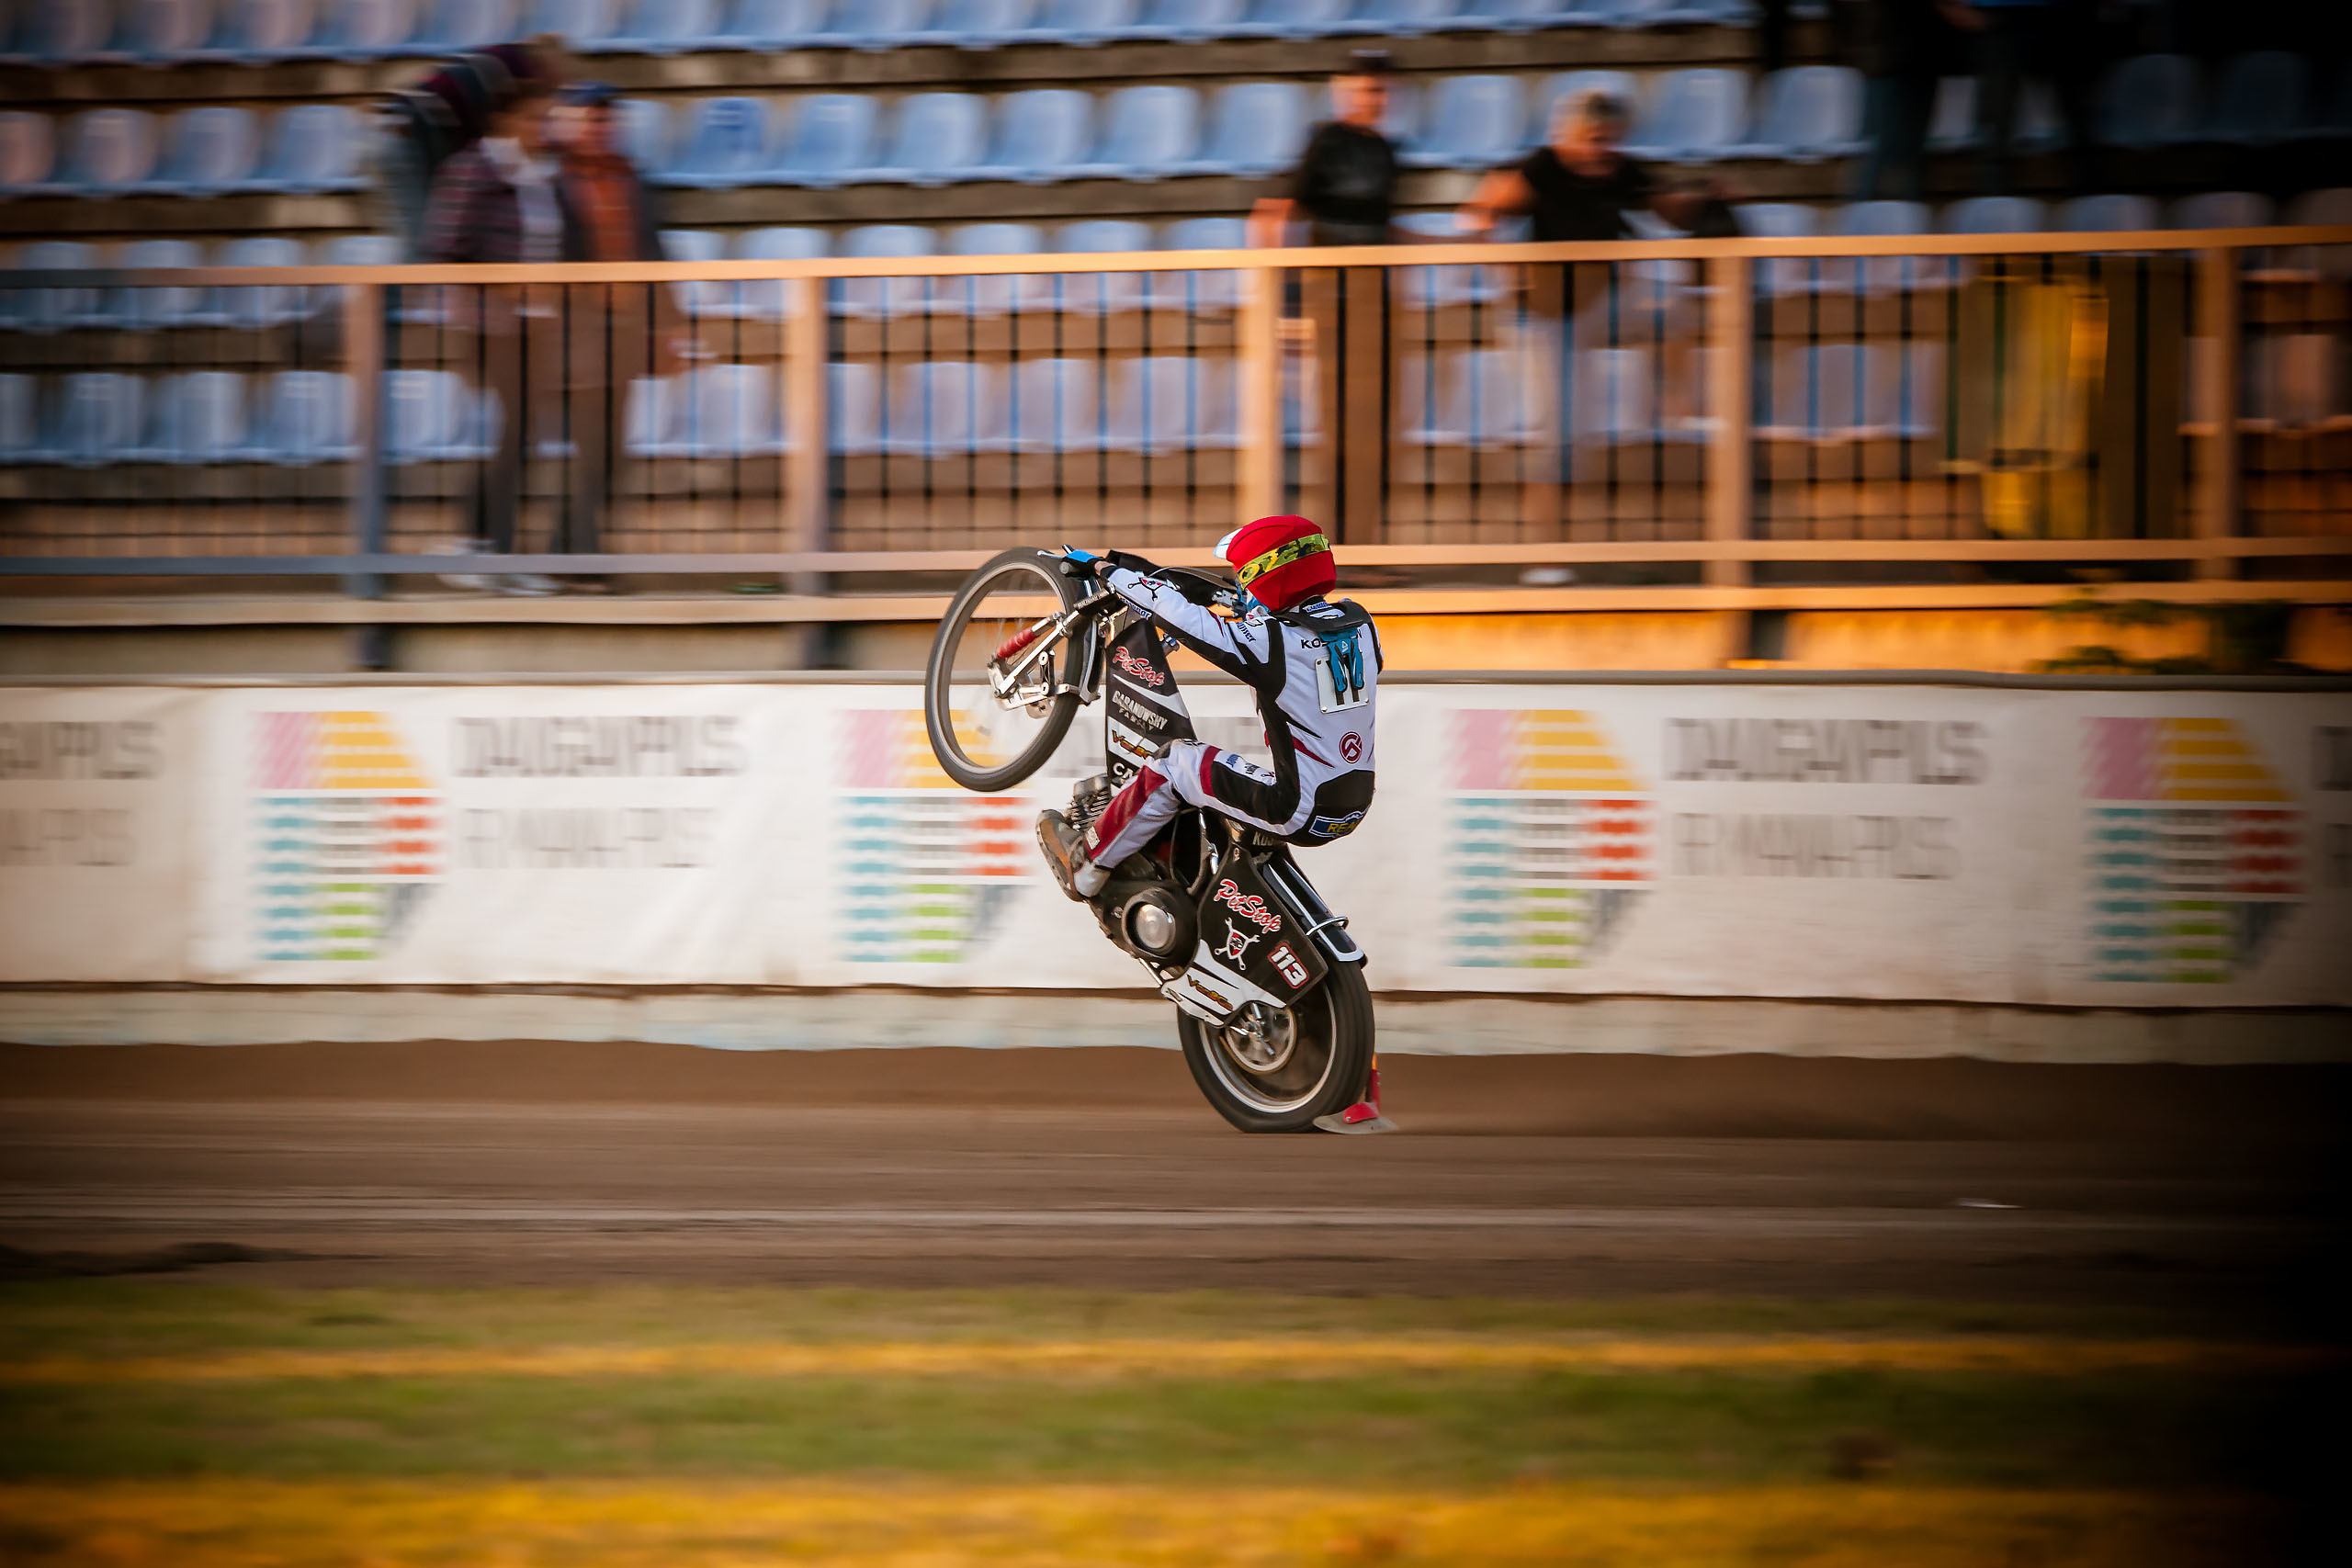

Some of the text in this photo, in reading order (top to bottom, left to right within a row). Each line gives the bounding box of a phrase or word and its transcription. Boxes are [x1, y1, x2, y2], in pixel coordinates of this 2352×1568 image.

[1113, 646, 1165, 687] PitStop
[1214, 878, 1282, 934] PitStop
[1271, 946, 1307, 987] 113
